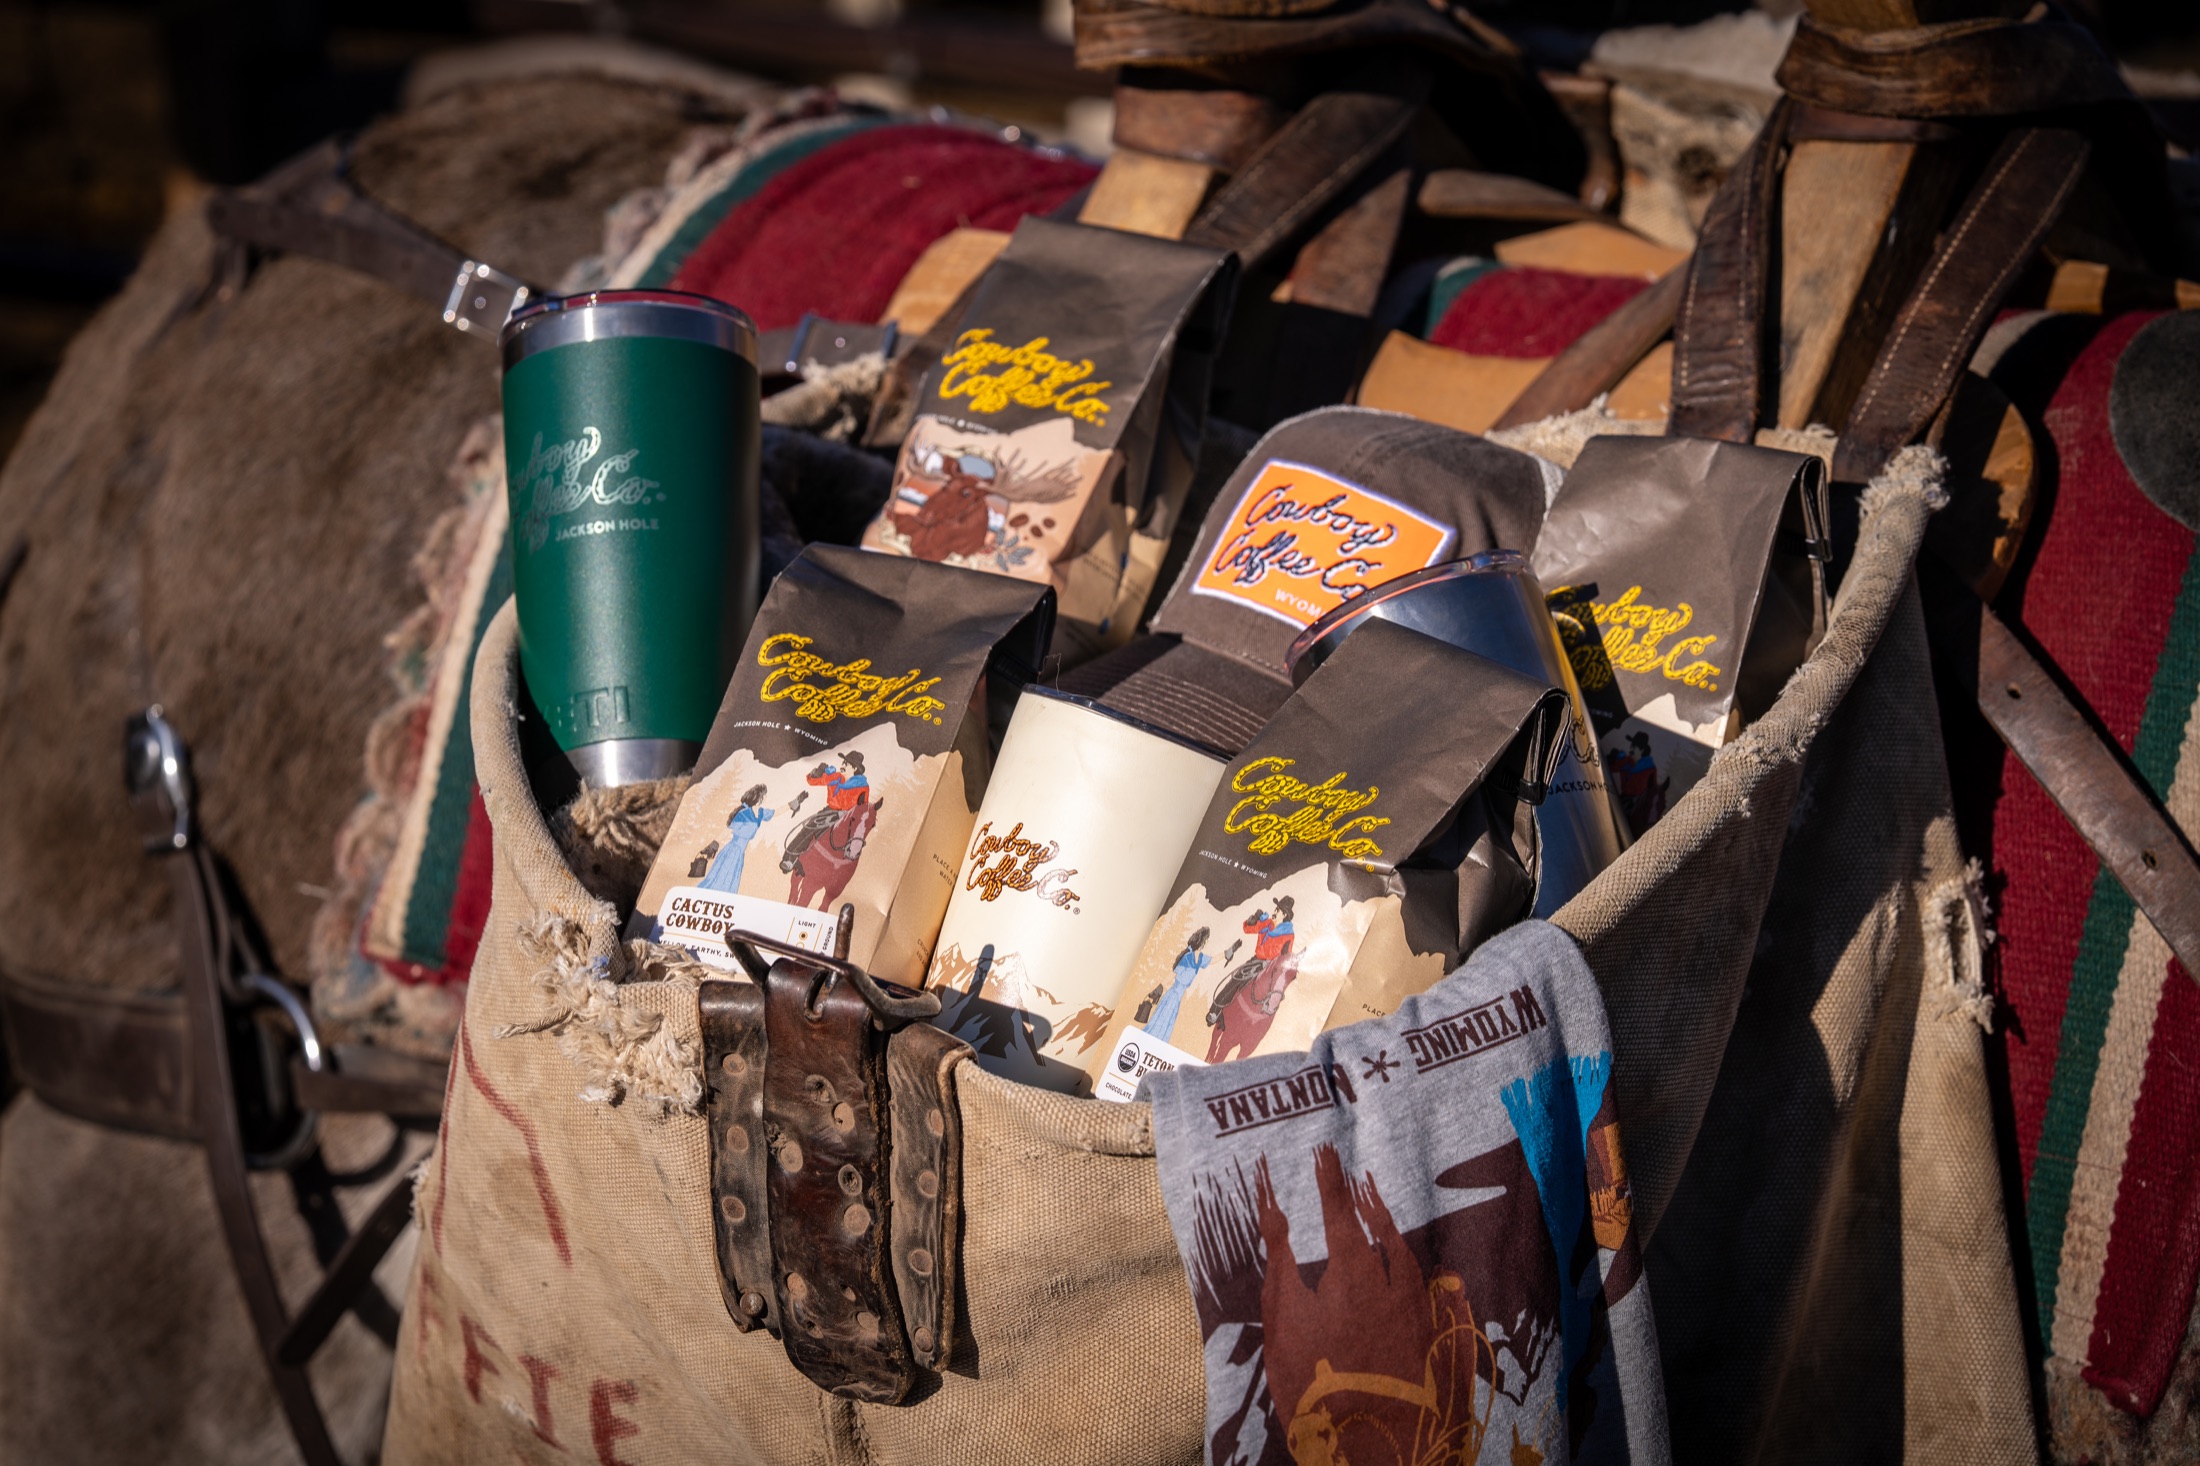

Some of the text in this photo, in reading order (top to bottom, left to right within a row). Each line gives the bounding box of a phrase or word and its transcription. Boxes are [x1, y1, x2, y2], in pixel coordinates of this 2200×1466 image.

[555, 518, 660, 542] JACKSON HOLE
[1244, 484, 1398, 556] Cowboy
[1213, 528, 1326, 588] Coffee
[1274, 588, 1327, 618] WYOM
[758, 633, 921, 703] Cowboy
[761, 667, 888, 723] Coffee
[734, 720, 829, 746] JACKSON HOLE WYOMING
[1231, 756, 1380, 826] Cowboy
[1547, 781, 1598, 796] JACKSON
[1224, 795, 1337, 856] Coffee
[969, 821, 1060, 873] Cowboy
[965, 853, 1039, 902] Coffee
[1218, 855, 1233, 865] HOLE
[1240, 864, 1268, 879] WYOMING
[665, 912, 736, 937] COWBOY
[671, 897, 735, 920] CACTUS
[797, 920, 817, 929] LIGHT
[822, 926, 834, 951] GROUND
[1406, 985, 1547, 1064] WYOMING
